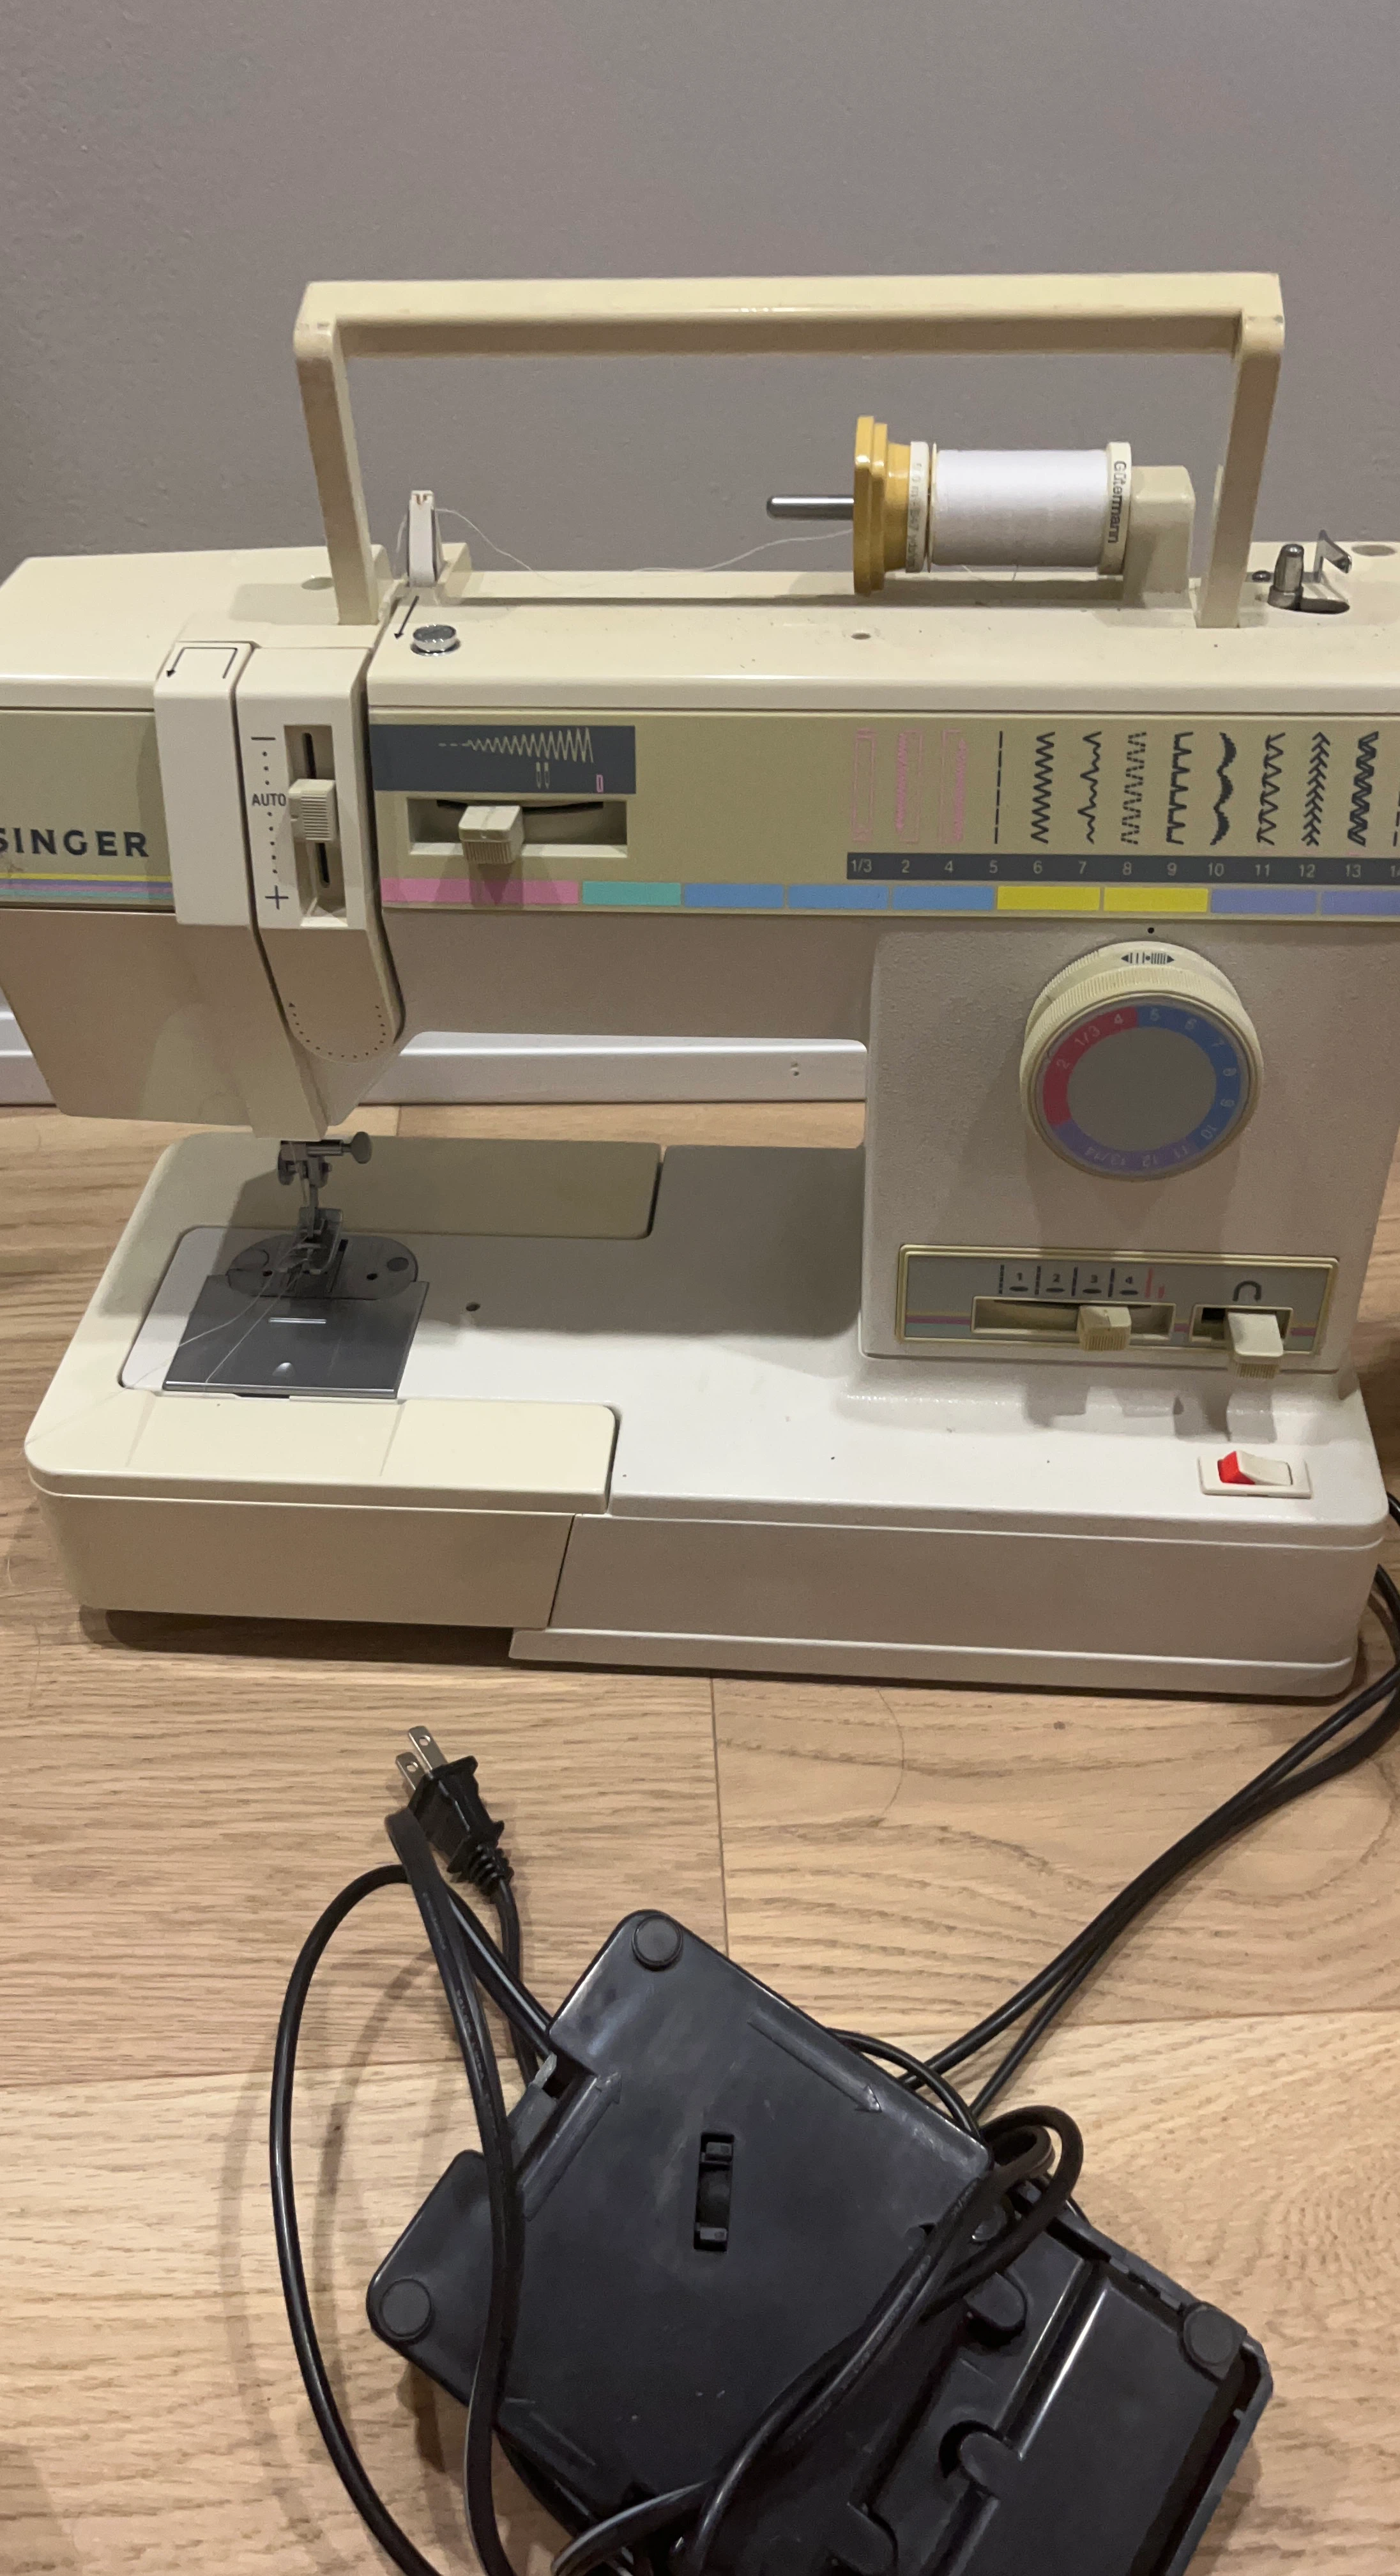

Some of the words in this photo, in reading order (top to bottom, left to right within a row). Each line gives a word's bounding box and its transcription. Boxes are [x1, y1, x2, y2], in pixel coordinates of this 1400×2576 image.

[1107, 460, 1127, 543] Gütermann
[252, 793, 287, 806] AUTO
[852, 859, 872, 873] 1/3
[901, 859, 910, 873] 2
[945, 861, 954, 873] 4
[989, 860, 998, 873] 5
[1033, 861, 1043, 875] 6
[1078, 861, 1087, 875] 7
[1122, 861, 1132, 876] 8
[1167, 862, 1177, 876] 9
[1208, 862, 1224, 877] 10
[1255, 864, 1270, 877] 11
[1299, 864, 1316, 878] 12
[1346, 864, 1362, 878] 13
[1074, 1025, 1100, 1046] 1/3
[1114, 1013, 1124, 1025] 4
[1150, 1008, 1161, 1022] 5
[1017, 1272, 1023, 1282] 1
[1053, 1273, 1061, 1283] 2
[1090, 1275, 1099, 1284] 3
